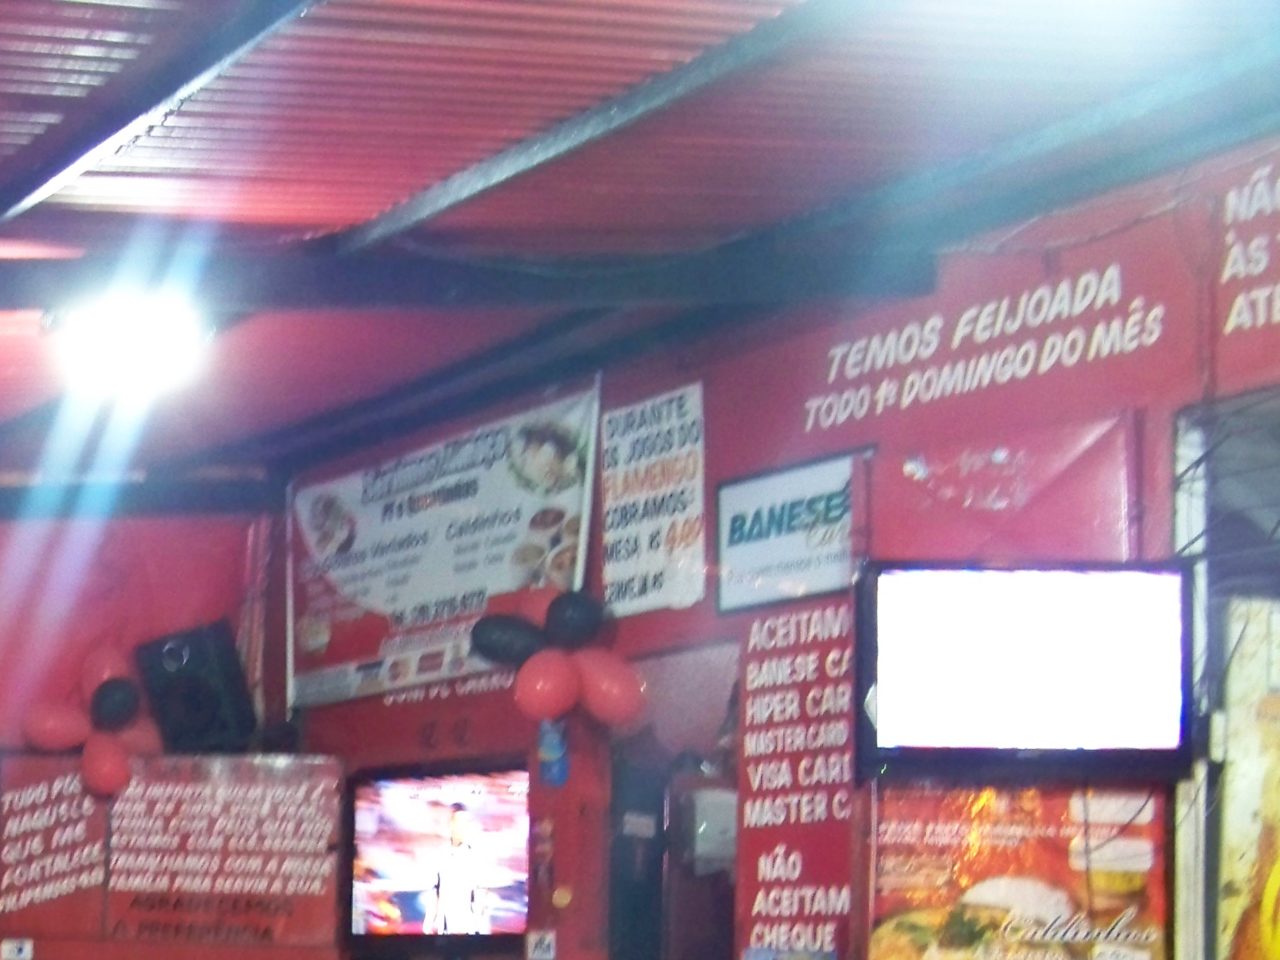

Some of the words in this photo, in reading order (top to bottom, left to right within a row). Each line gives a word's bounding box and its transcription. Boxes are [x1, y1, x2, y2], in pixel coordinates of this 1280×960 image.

[1225, 163, 1280, 226] NÃ
[827, 314, 944, 384] TEMOS
[951, 263, 1120, 352] FEIJOADA
[804, 384, 871, 433] TODO
[900, 341, 1036, 410] DOMINGO
[1038, 331, 1084, 376] DO
[1087, 296, 1166, 362] MÊS
[727, 489, 847, 548] BANESE
[748, 604, 851, 653] ACEITAM
[746, 650, 820, 692] BANESE
[746, 689, 800, 727] HIPER
[746, 757, 793, 792] VISA
[1, 781, 49, 815] TUDO
[3, 795, 96, 839] NAQUELE
[744, 790, 827, 829] MASTER
[1, 833, 45, 864] QUE
[51, 820, 87, 850] ME
[757, 842, 803, 882] NÃO
[172, 874, 213, 893] PARA
[212, 876, 270, 895] SERVIR
[223, 854, 265, 874] COM
[280, 853, 337, 877] NOSSA
[751, 882, 852, 917] ACEITAM
[750, 922, 836, 952] CHEQUE
